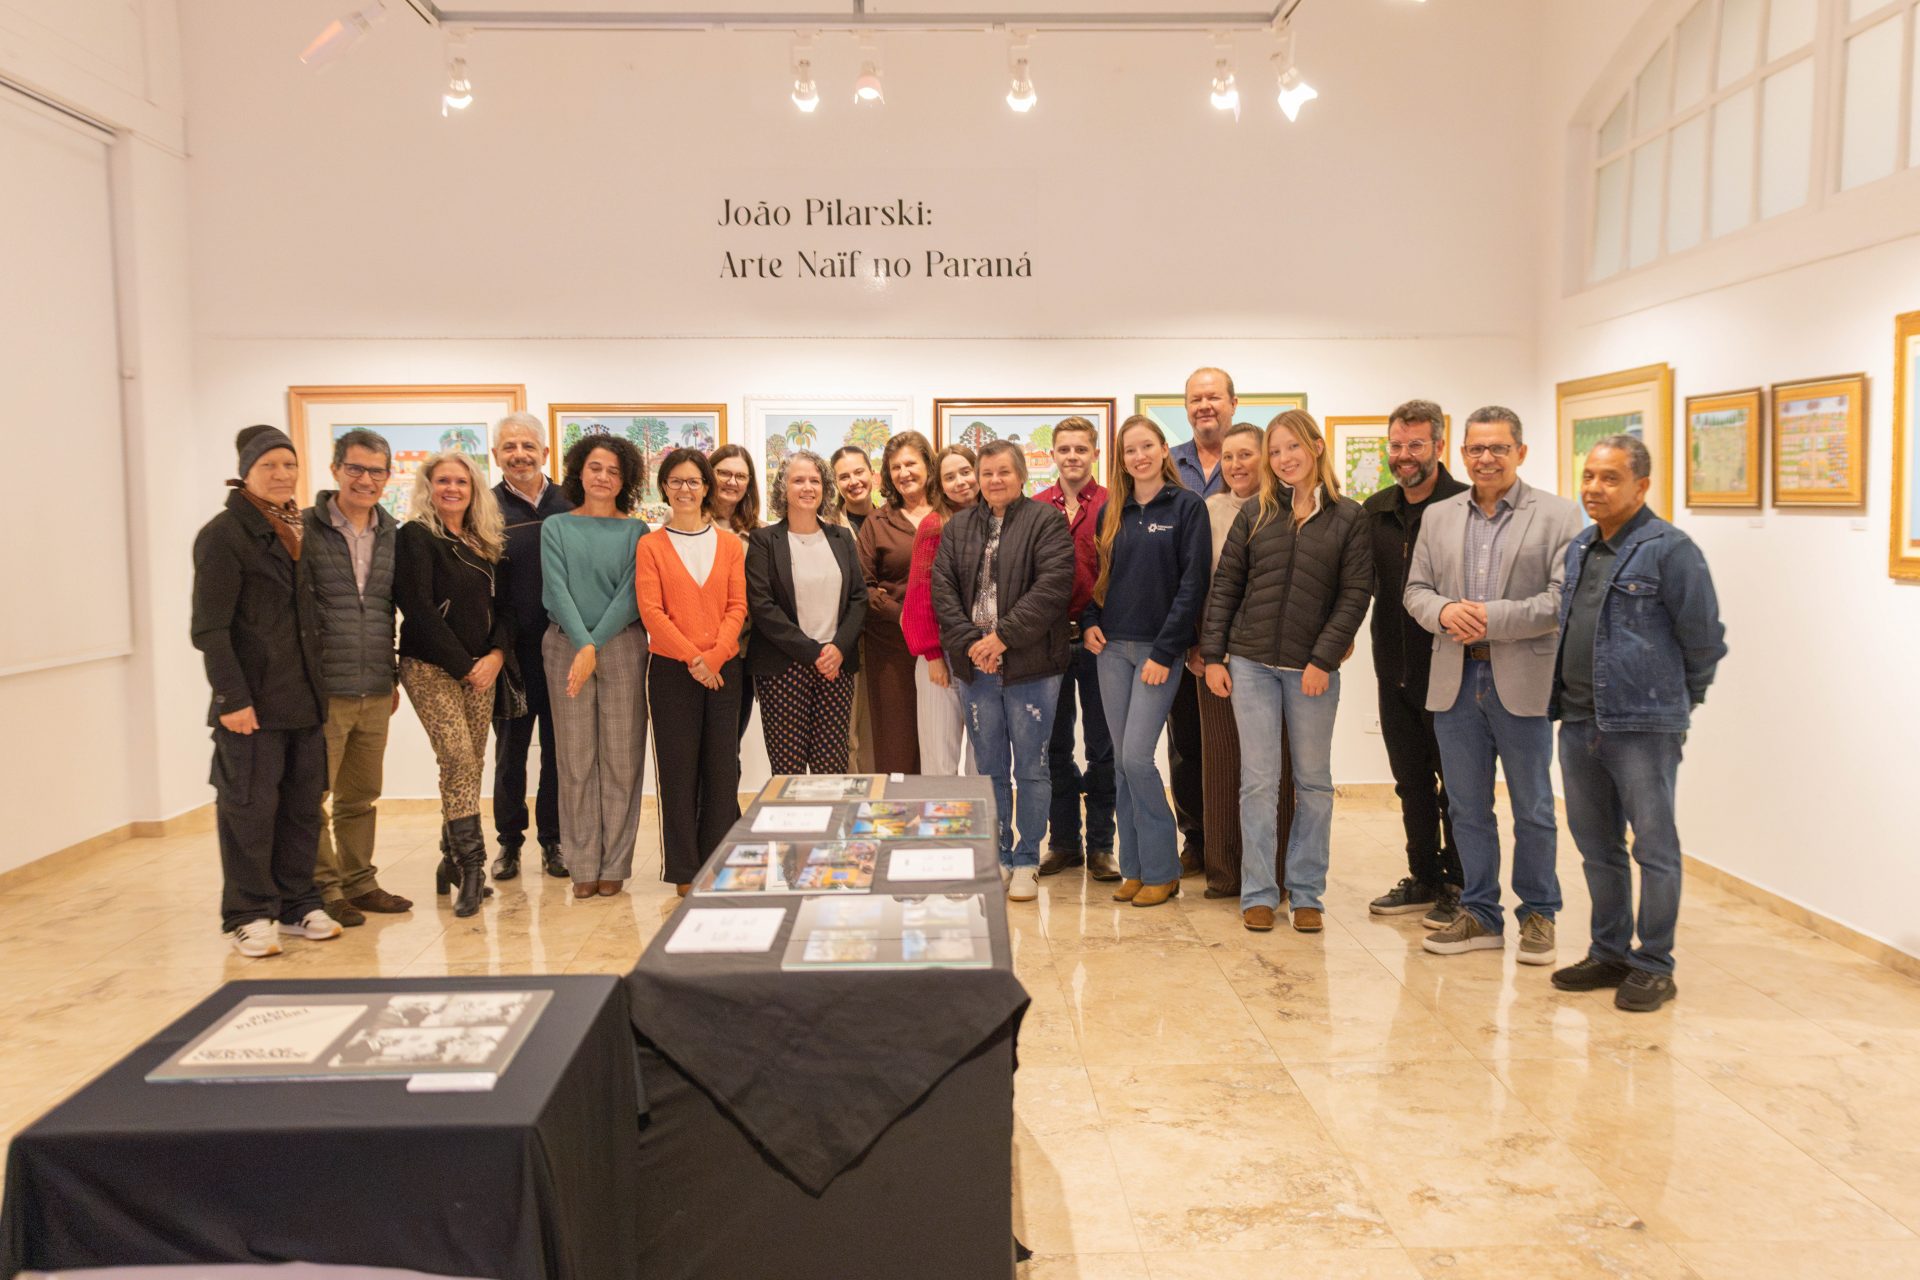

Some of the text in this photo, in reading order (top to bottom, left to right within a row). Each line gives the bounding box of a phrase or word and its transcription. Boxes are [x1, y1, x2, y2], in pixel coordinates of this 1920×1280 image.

[718, 199, 932, 227] João Pilarski:
[720, 250, 1032, 278] Arte Naïf no Paraná
